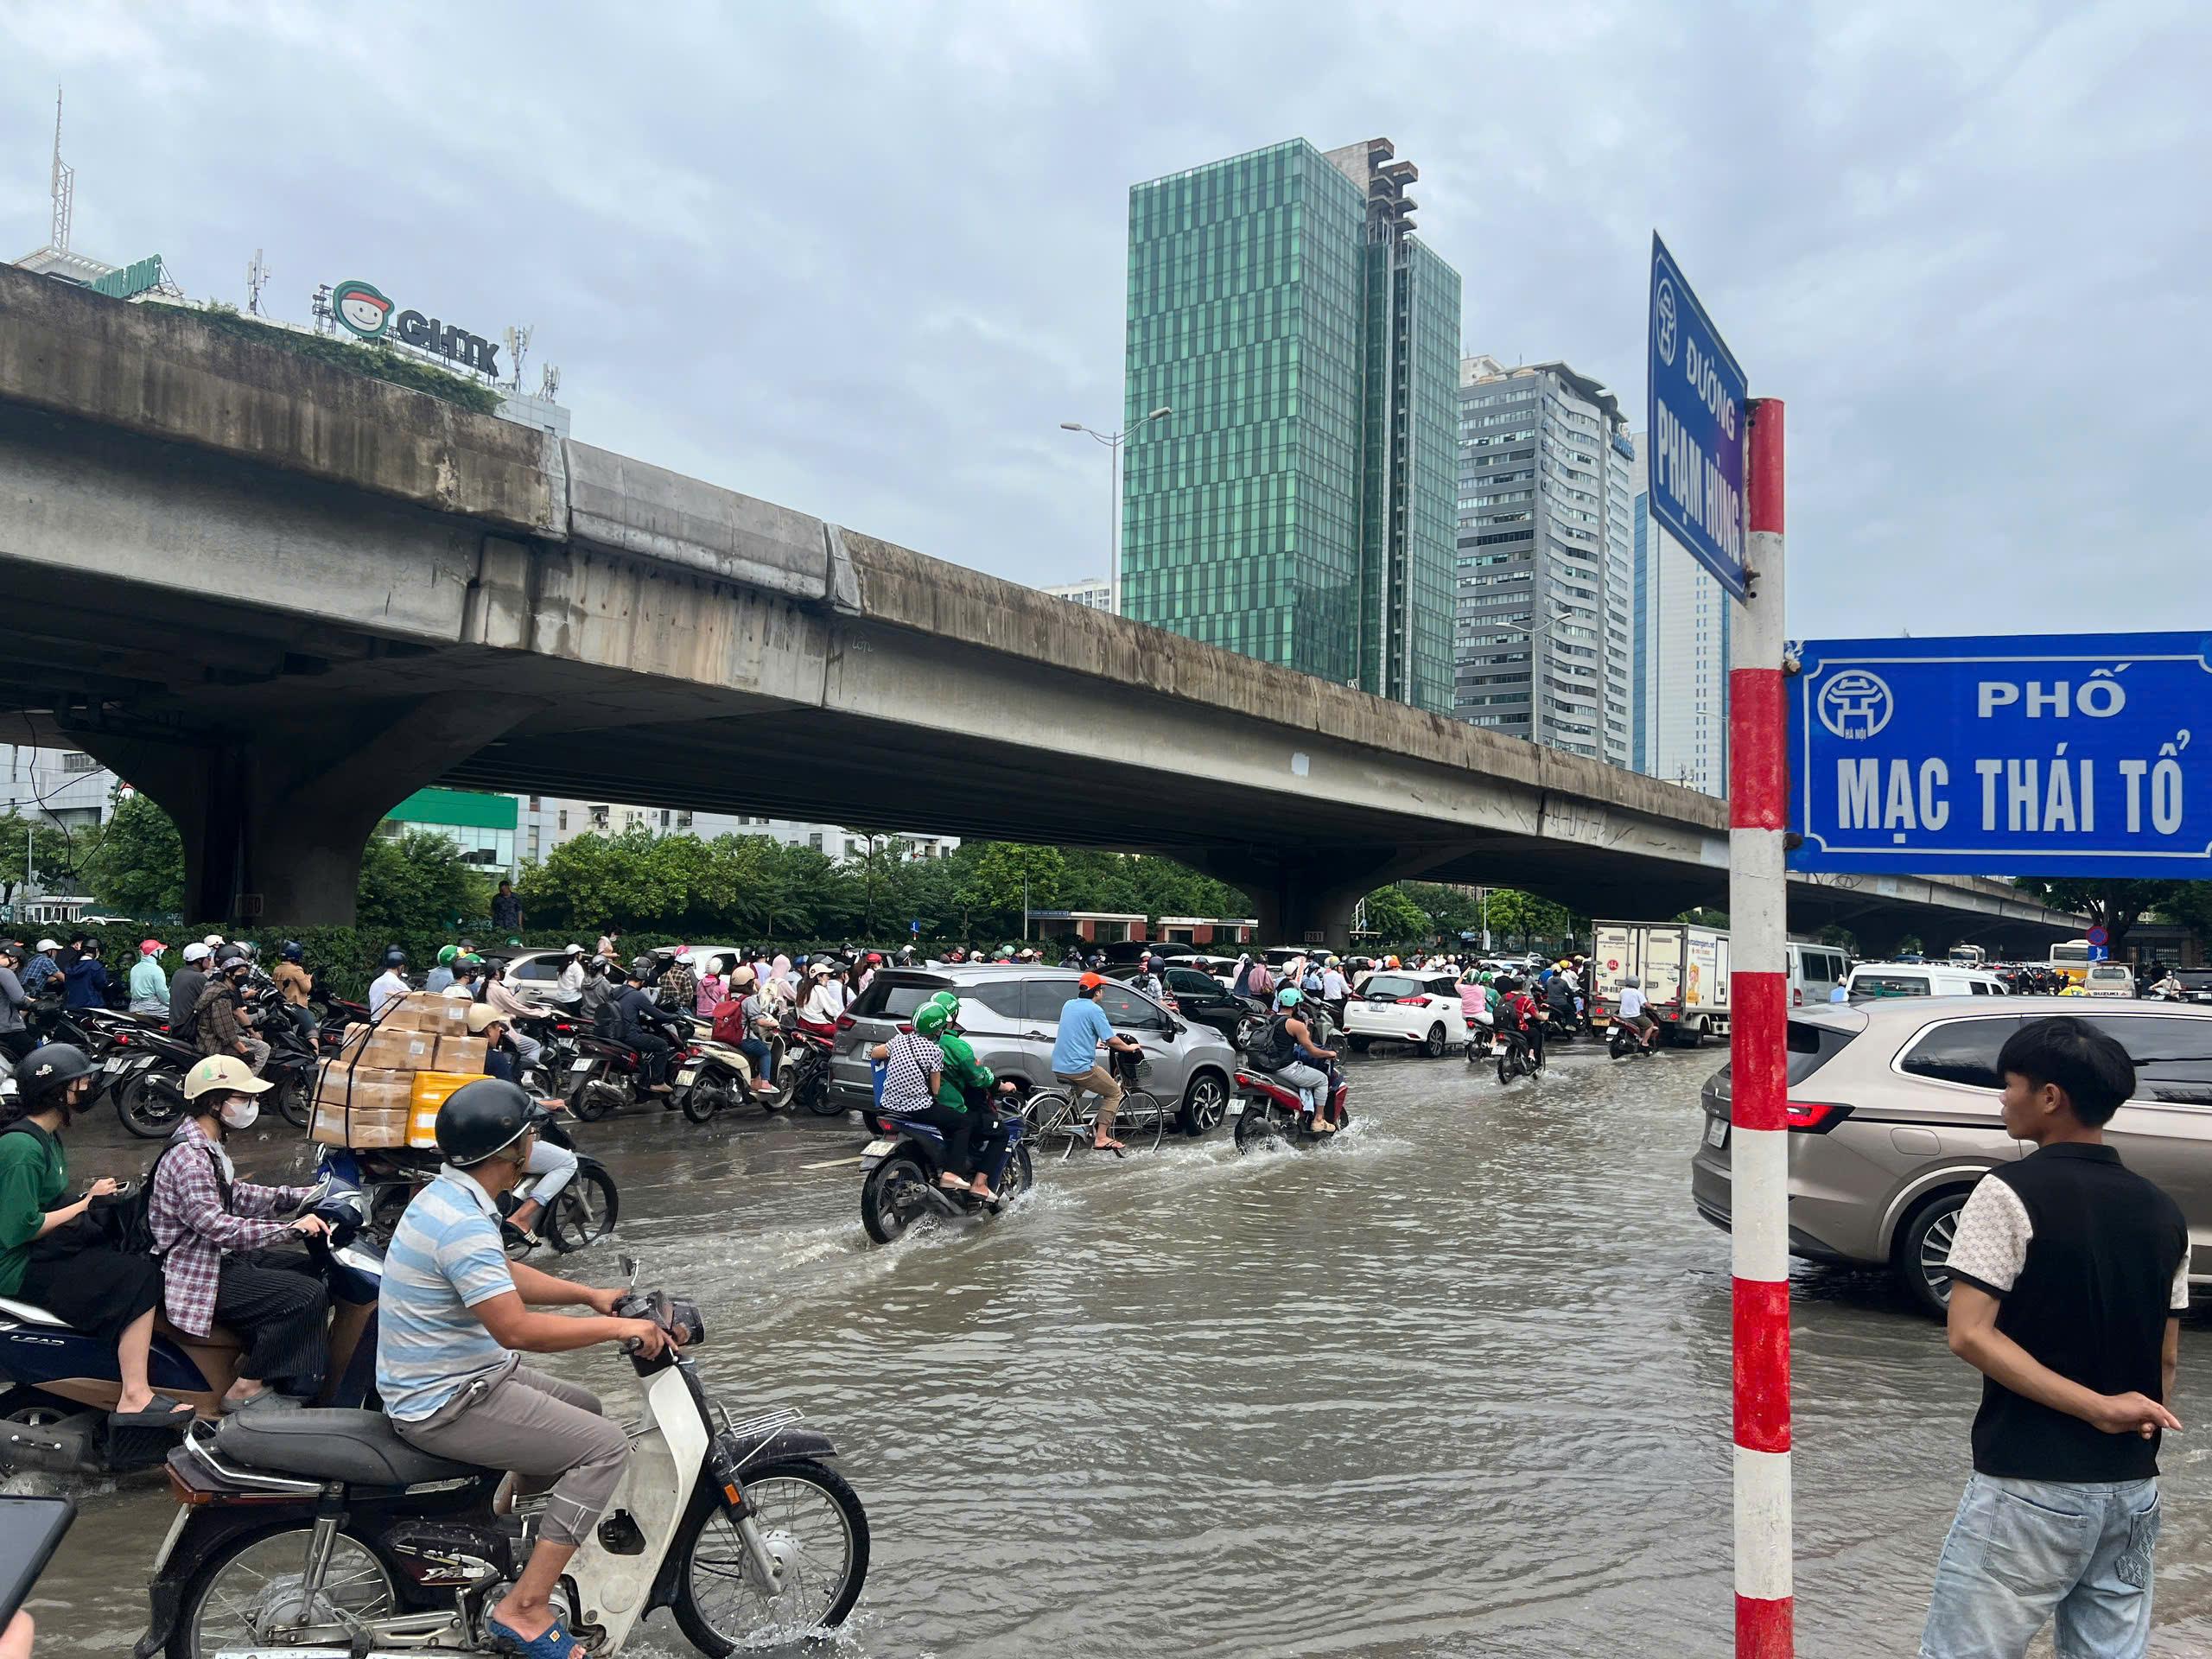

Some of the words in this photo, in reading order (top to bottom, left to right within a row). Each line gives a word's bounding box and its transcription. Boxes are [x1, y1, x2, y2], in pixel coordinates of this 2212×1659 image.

[397, 309, 499, 377] GHTK
[1686, 335, 1735, 442] ĐƯỜNG
[1657, 397, 1703, 526] PHẠM
[1706, 451, 1740, 567] HÙNG
[1977, 663, 2133, 718] PHỐ
[1837, 757, 1949, 844] MẠC
[1975, 741, 2094, 833] THÁI
[2119, 728, 2191, 836] TỔ
[929, 1018, 943, 1028] Grab
[10, 1335, 65, 1346] LEAD
